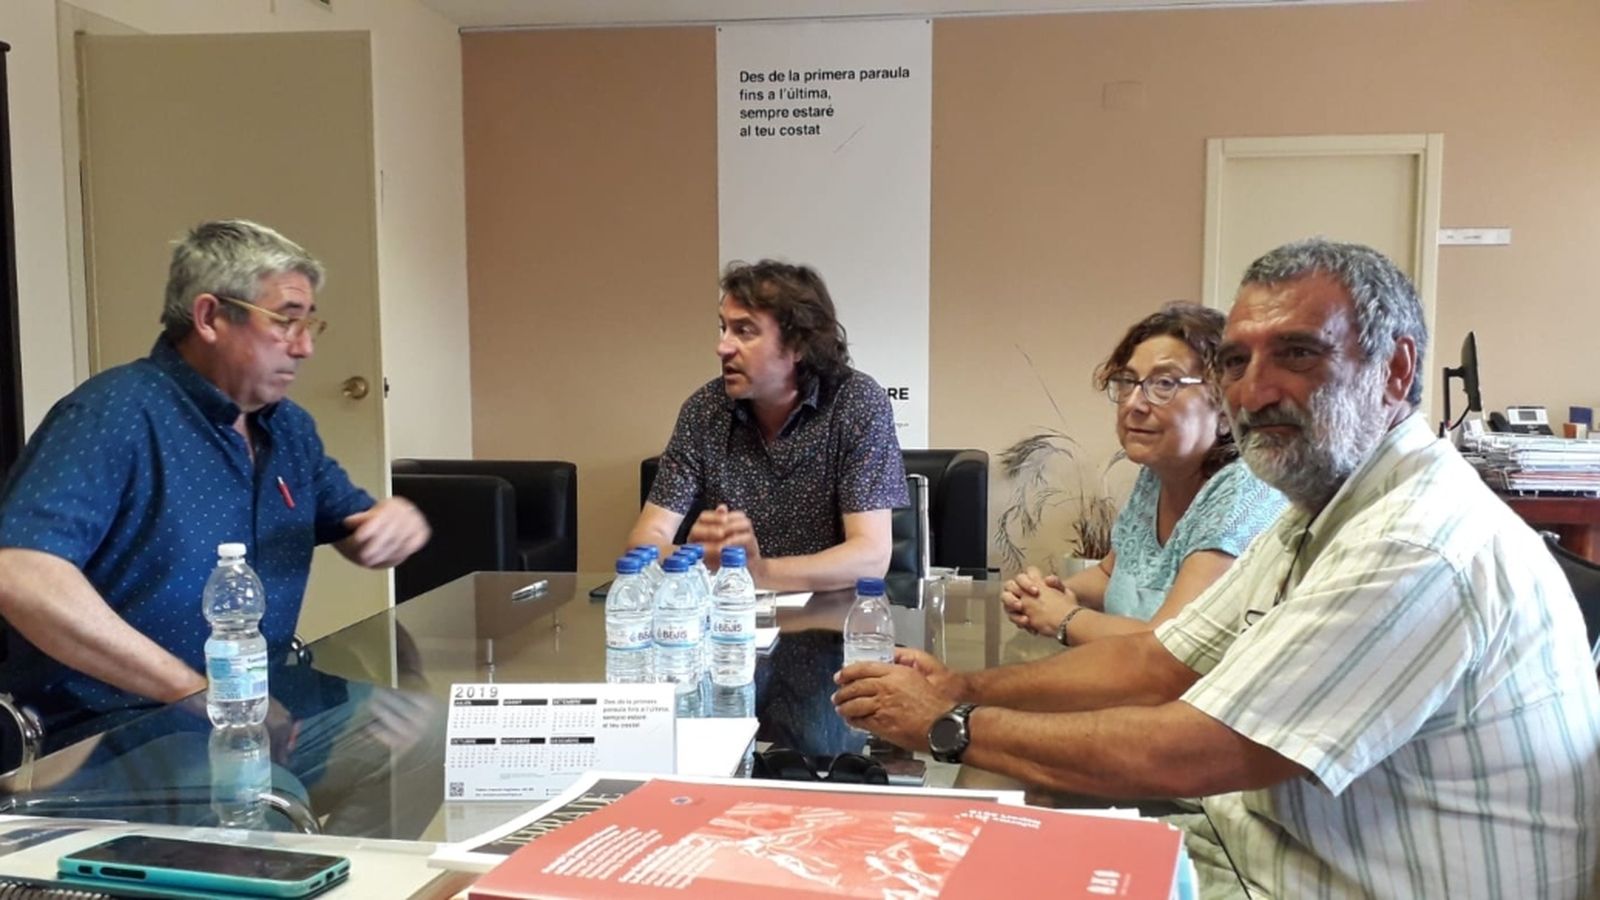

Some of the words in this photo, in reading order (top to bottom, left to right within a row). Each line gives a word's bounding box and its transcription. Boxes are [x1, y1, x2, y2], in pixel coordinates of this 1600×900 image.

[740, 70, 765, 83] Des
[768, 69, 785, 82] de
[788, 69, 800, 82] la
[803, 68, 856, 84] primera
[859, 66, 910, 82] paraula
[739, 88, 764, 101] fins
[767, 91, 776, 101] a
[739, 107, 789, 121] sempre
[792, 104, 834, 118] estaré
[739, 125, 752, 137] al
[755, 125, 776, 137] teu
[779, 124, 821, 136] costat
[882, 387, 909, 400] RE
[454, 686, 498, 698] 2019
